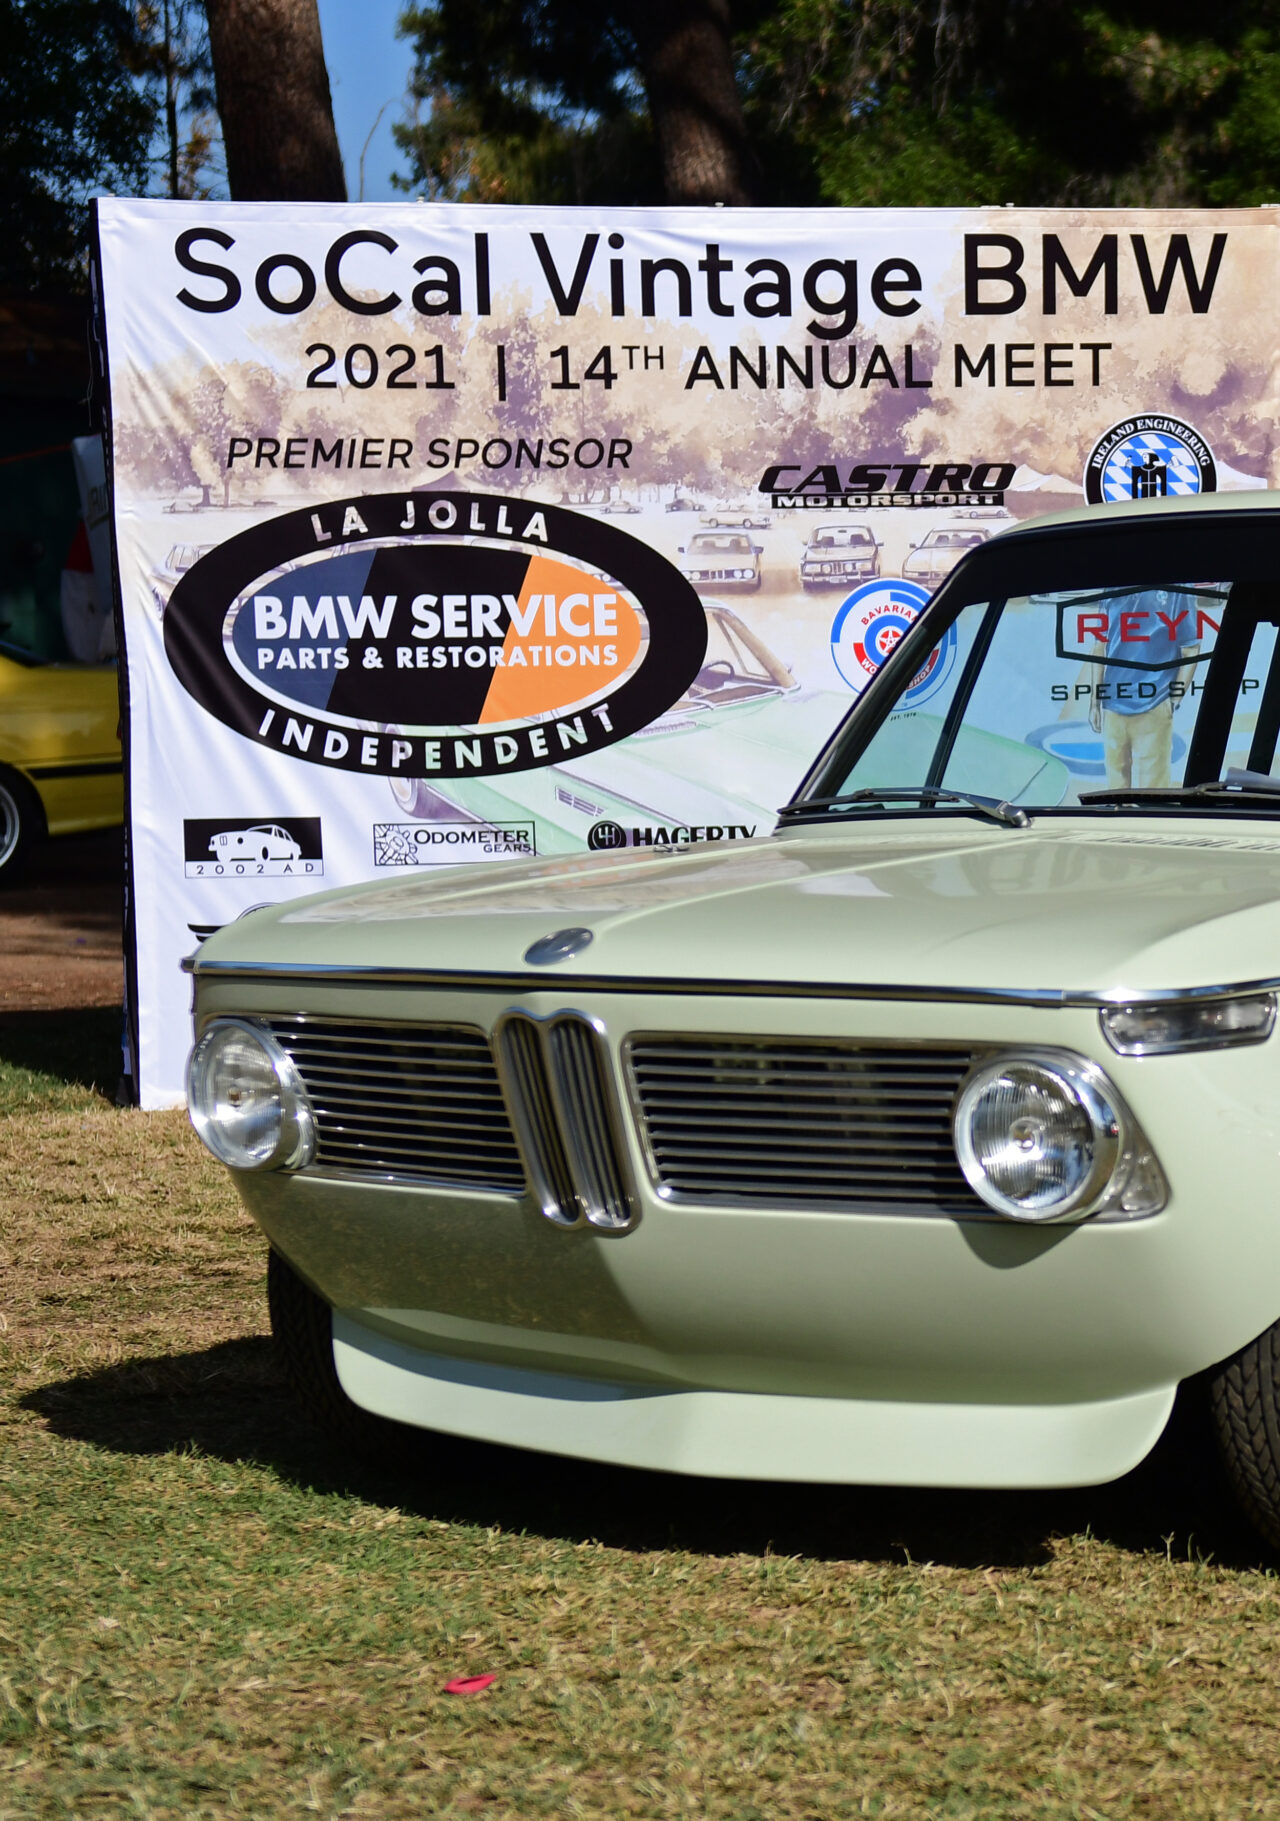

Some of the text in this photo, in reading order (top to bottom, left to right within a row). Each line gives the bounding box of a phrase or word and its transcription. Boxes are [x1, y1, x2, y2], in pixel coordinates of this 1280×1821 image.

[174, 227, 1228, 341] SoCal Vintage BMW
[304, 342, 456, 390] 2021
[684, 343, 933, 390] ANNUAL
[953, 342, 1112, 388] MEET
[226, 437, 633, 470] PREMIER SPONSOR
[1091, 418, 1211, 470] IRELAND ENGINEERING
[758, 462, 1017, 494] CASTRO
[776, 492, 999, 508] MOTORSPORT
[310, 499, 549, 543] LA JOLLA
[253, 593, 618, 640] BMW SERVICE
[257, 644, 619, 670] PARTS & RESTORATIONS
[1050, 678, 1260, 701] SPEED SHP
[258, 702, 615, 770] INDEPENDENT
[413, 829, 529, 845] ODOMETER
[483, 843, 531, 853] GEARS
[632, 824, 758, 847] HAGERTY
[195, 864, 265, 876] 2002
